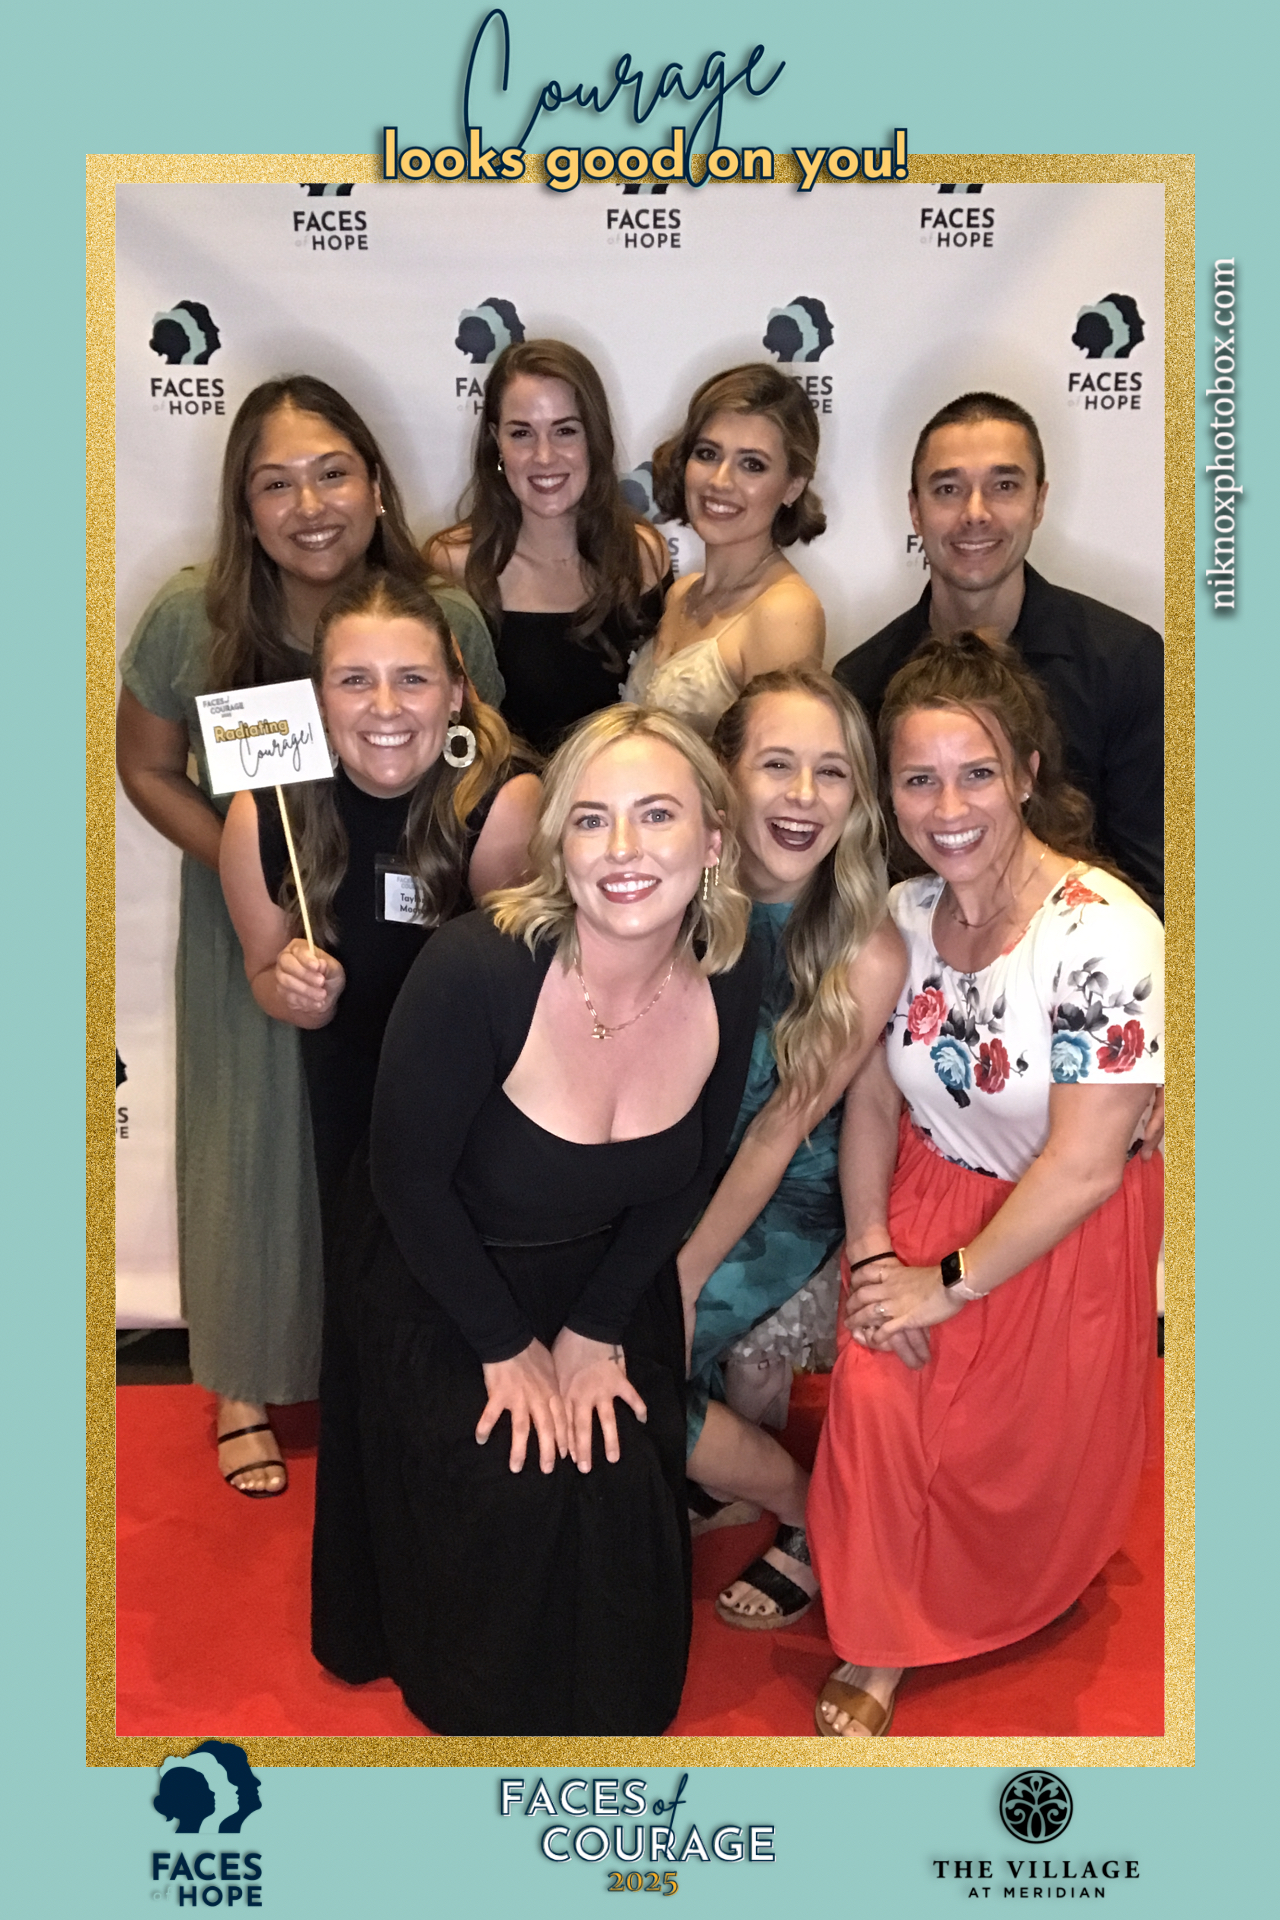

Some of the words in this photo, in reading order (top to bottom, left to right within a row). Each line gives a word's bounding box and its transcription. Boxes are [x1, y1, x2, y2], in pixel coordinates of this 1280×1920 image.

[293, 210, 367, 231] FACES
[607, 208, 681, 229] FACES
[920, 207, 995, 228] FACES
[312, 234, 368, 250] HOPE
[624, 232, 681, 248] HOPE
[937, 231, 994, 247] HOPE
[150, 377, 224, 397] FACES
[1068, 371, 1142, 392] FACES
[169, 400, 226, 415] HOPE
[1084, 394, 1141, 410] HOPE
[213, 719, 290, 743] Radiating
[238, 722, 314, 778] Courage!
